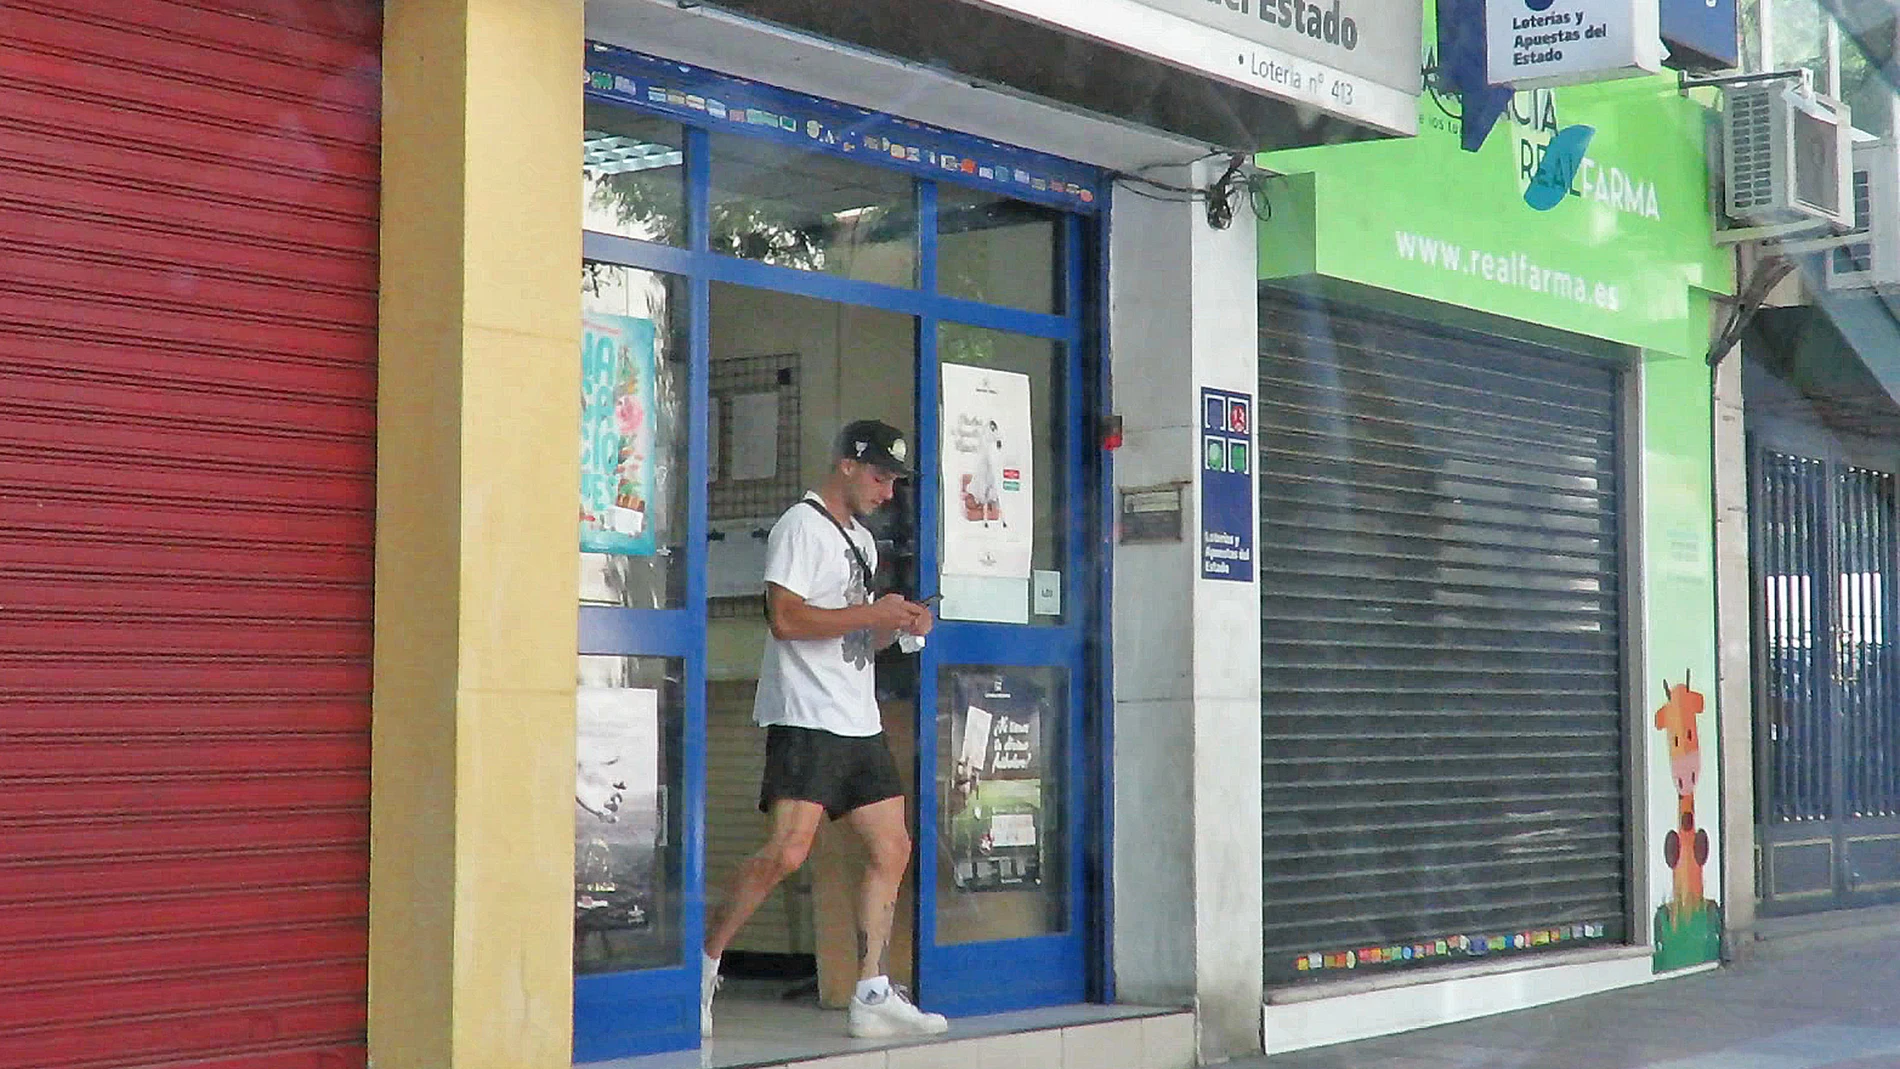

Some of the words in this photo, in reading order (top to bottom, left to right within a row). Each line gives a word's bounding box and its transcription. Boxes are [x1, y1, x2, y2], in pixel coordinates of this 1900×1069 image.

[1575, 10, 1584, 25] y
[1513, 29, 1580, 50] Apuestas
[1584, 23, 1606, 39] del
[1513, 48, 1563, 66] Estado
[1331, 79, 1353, 105] 413
[1395, 230, 1619, 312] www.realfarma.es
